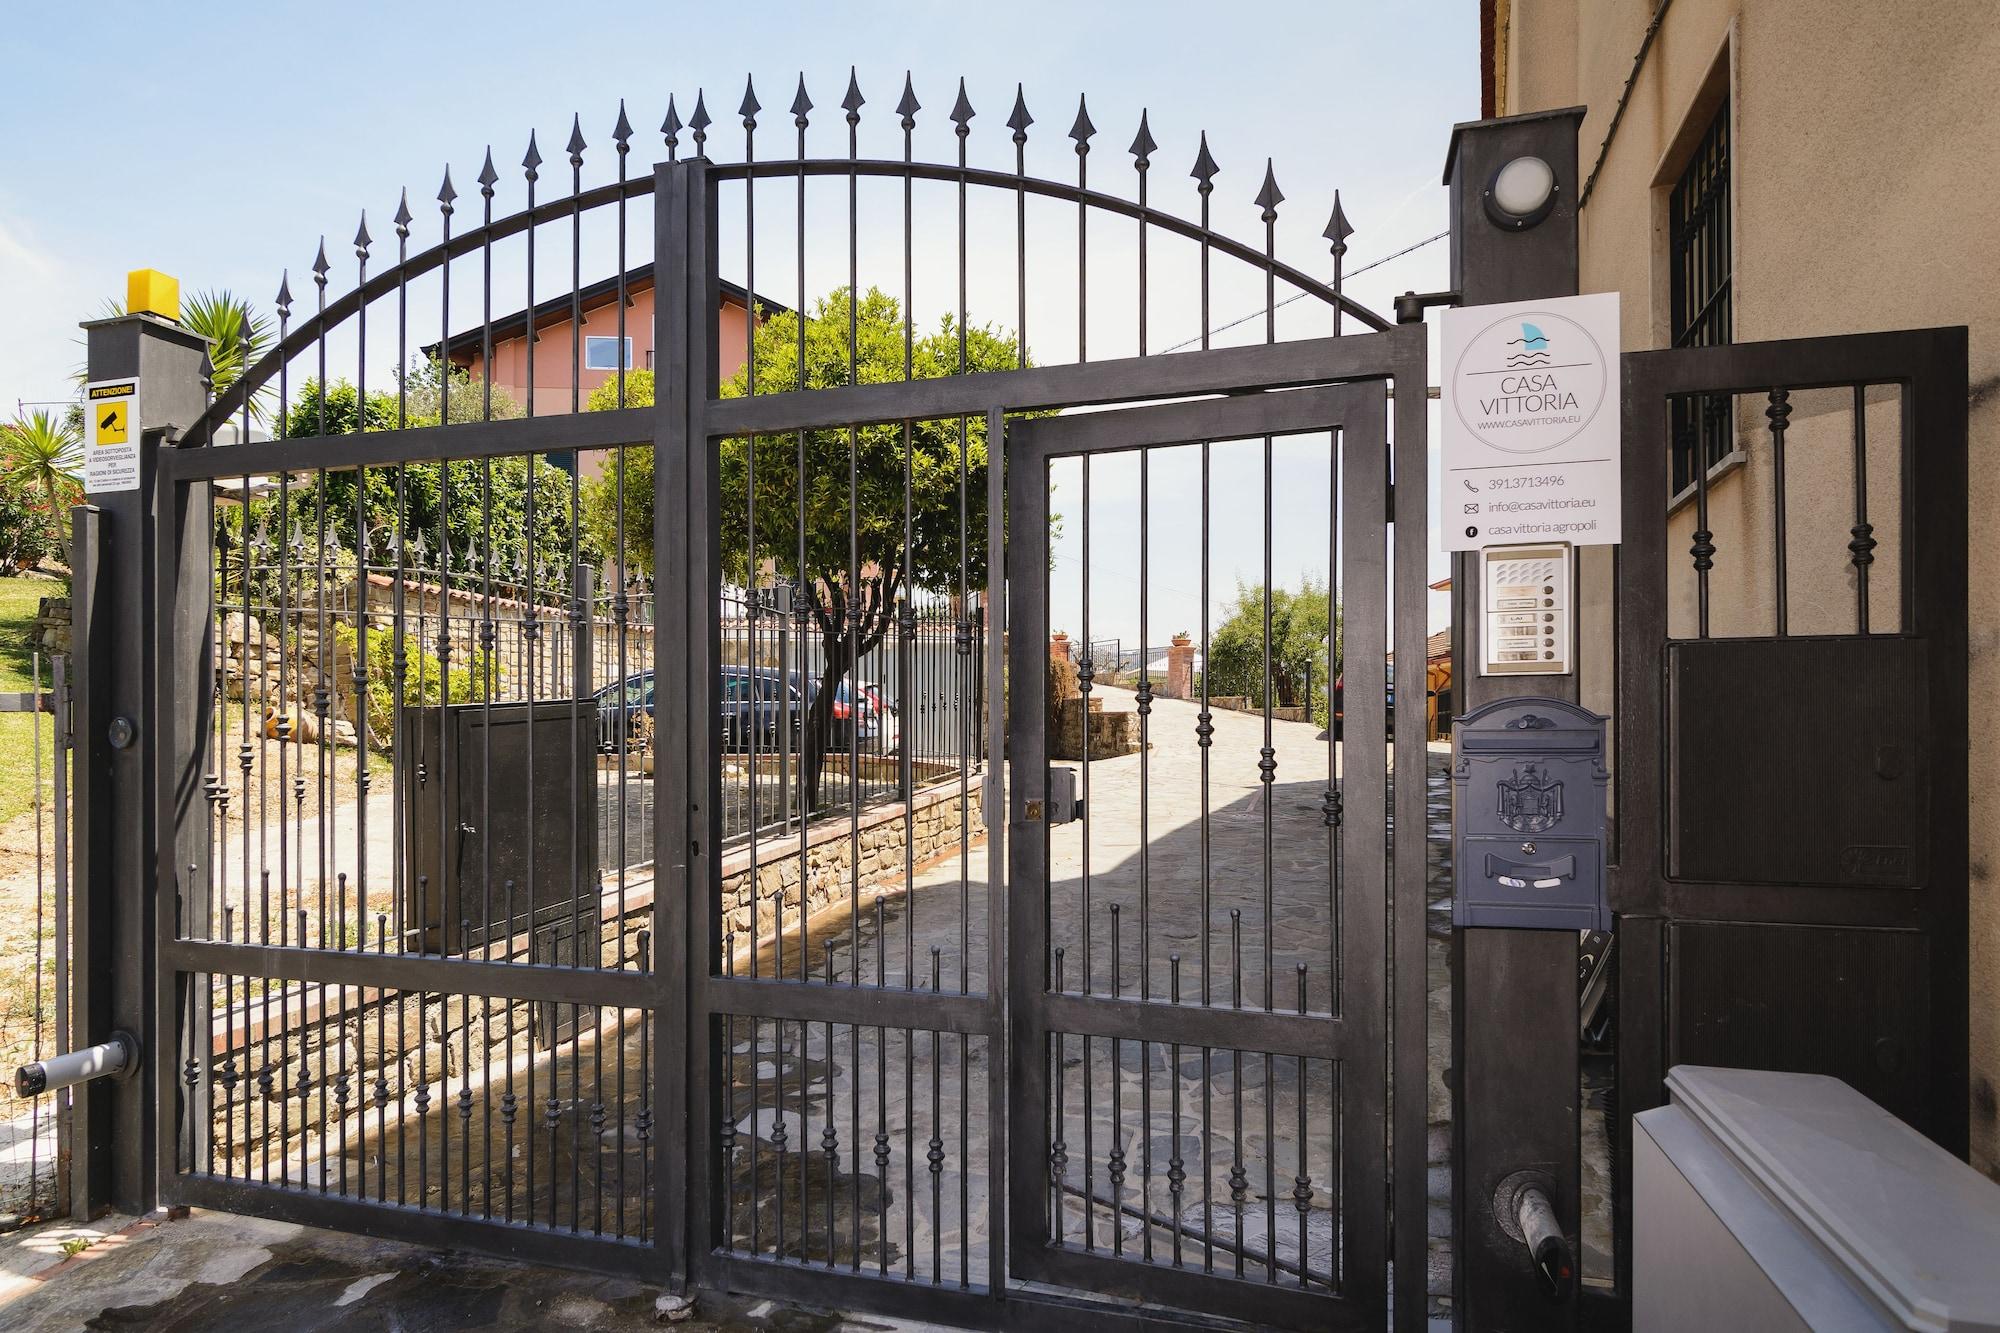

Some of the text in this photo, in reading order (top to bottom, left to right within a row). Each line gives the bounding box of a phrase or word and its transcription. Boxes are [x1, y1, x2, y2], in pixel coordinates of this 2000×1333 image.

[1500, 373, 1558, 394] CASA
[91, 385, 133, 398] ATTENZIONE!
[1479, 392, 1579, 416] VITTORIA
[1477, 415, 1581, 430] WWW.CASAVITTORIA.EU
[105, 447, 132, 455] SOTTOPOSTA
[1488, 475, 1565, 490] 391.3713496
[1488, 497, 1596, 513] info@casavittoria.eu
[1488, 519, 1597, 535] casa vittoria agropoli
